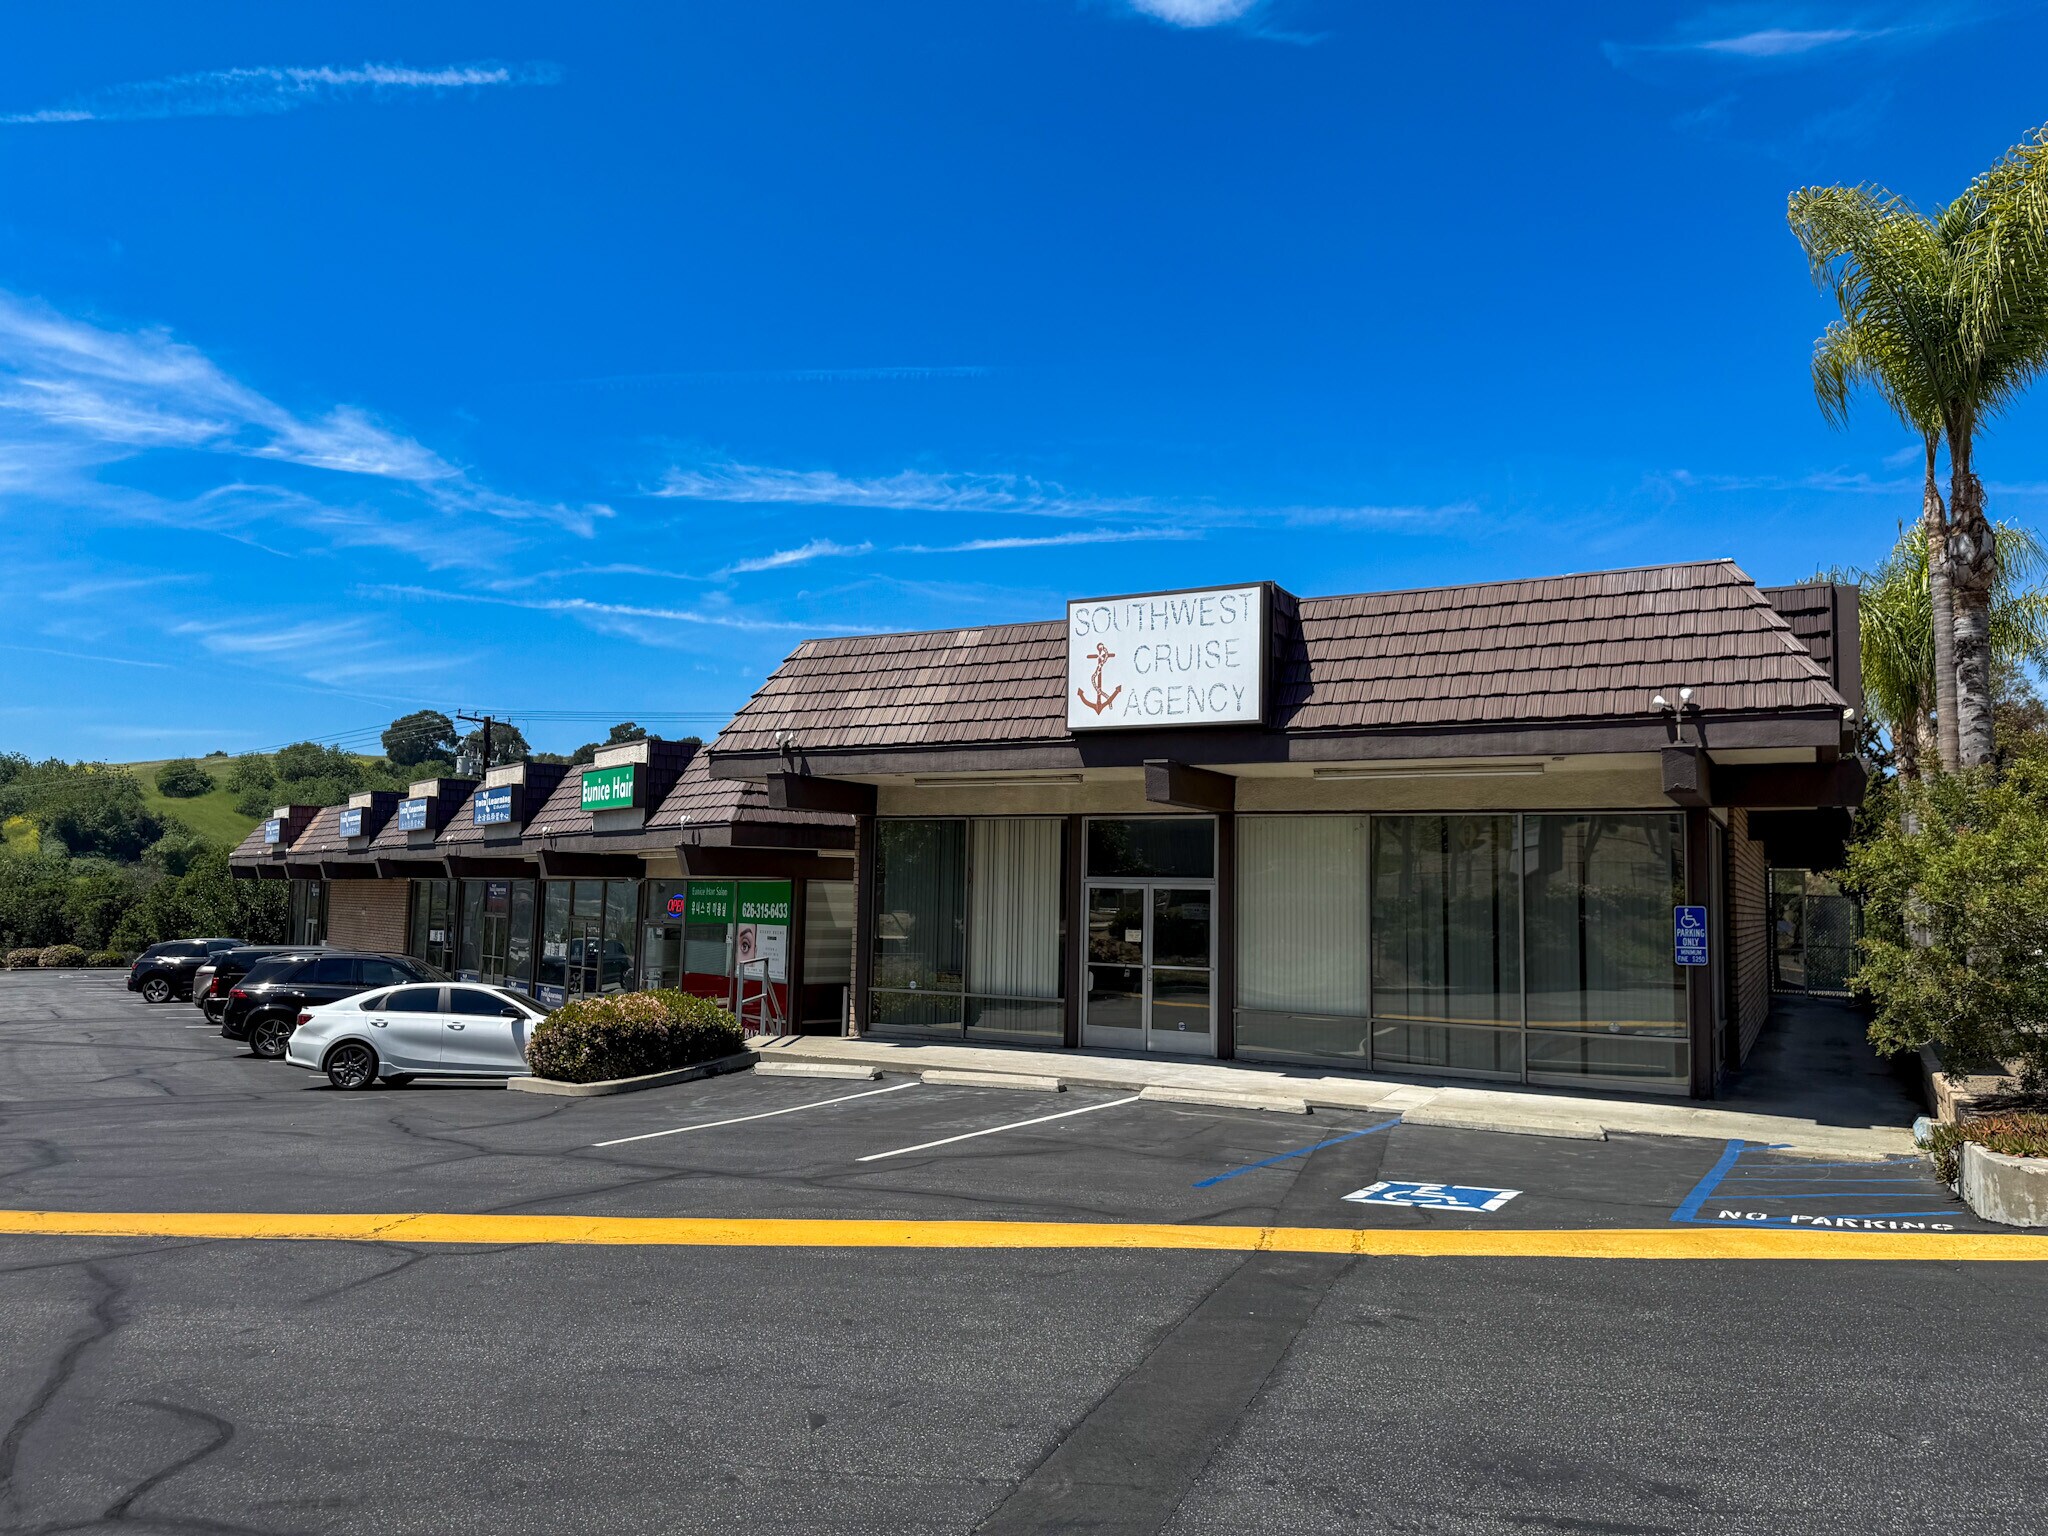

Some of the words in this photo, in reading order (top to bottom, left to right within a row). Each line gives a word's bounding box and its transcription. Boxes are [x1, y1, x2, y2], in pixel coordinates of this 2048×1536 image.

[1075, 593, 1253, 637] SOUTHWEST
[1133, 638, 1241, 674] CRUISE
[1123, 682, 1245, 717] AGENCY
[582, 777, 610, 803] Eunice
[612, 773, 634, 799] Hair
[691, 886, 706, 896] Eunice
[706, 887, 716, 896] Hair
[716, 887, 728, 897] Salon
[742, 902, 788, 919] 626-315-6433
[1676, 928, 1705, 938] PARKING
[1682, 938, 1699, 946] ONLY
[1677, 955, 1689, 963] FINE
[1718, 1209, 1768, 1221] NO
[1790, 1214, 1956, 1232] PARKING
